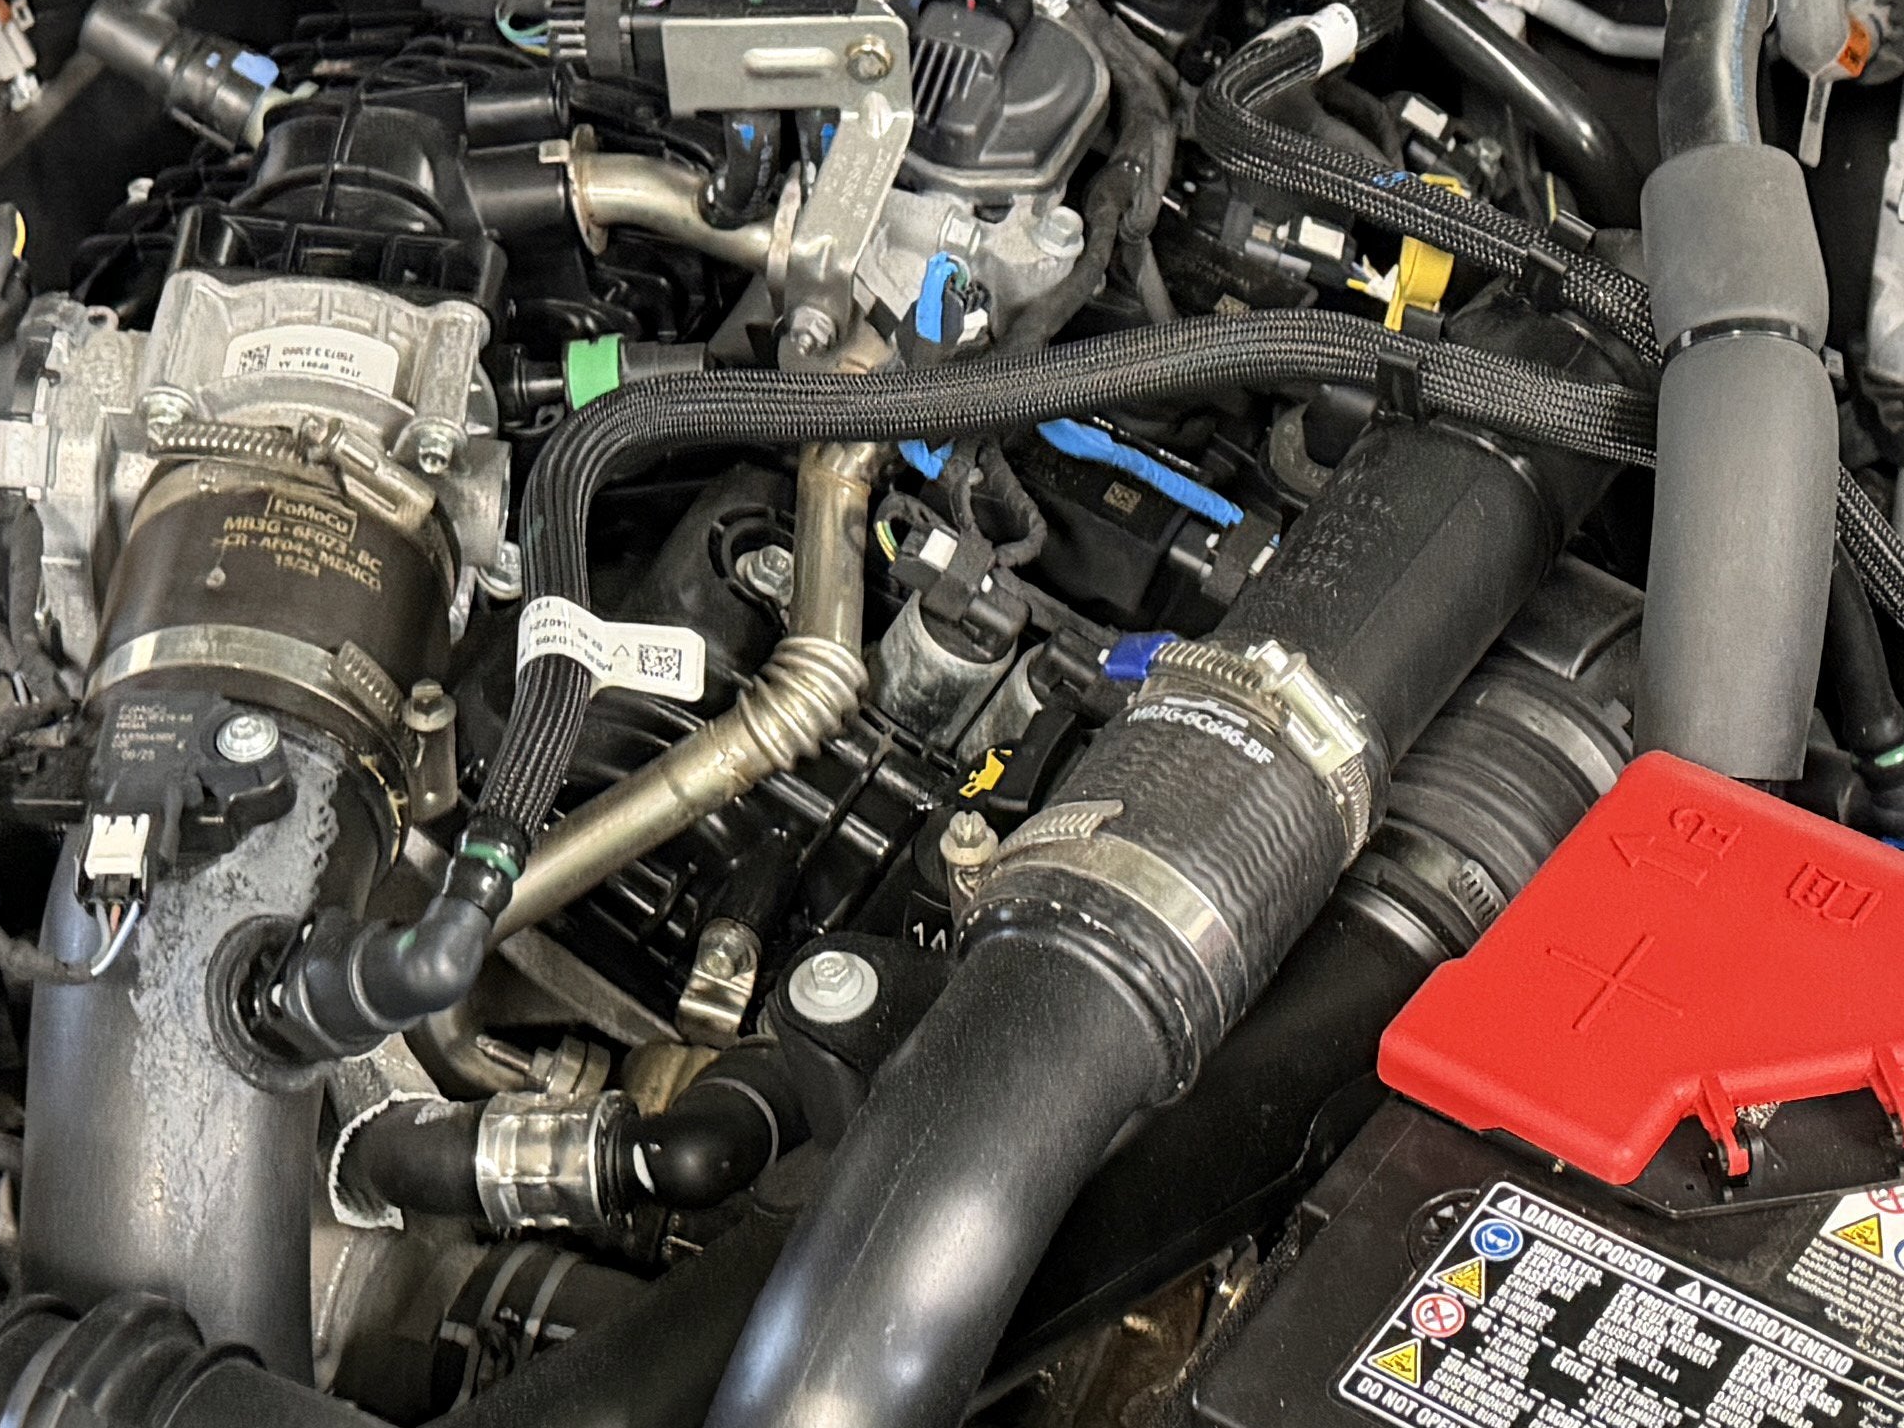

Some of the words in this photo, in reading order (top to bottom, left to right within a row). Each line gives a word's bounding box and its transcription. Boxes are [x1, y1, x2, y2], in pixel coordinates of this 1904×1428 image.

[1518, 1202, 1669, 1285] DANGER/POISON
[1527, 1239, 1574, 1269] SHIELD
[1502, 1272, 1543, 1299] CAUSE
[1510, 1261, 1554, 1290] GASES
[1547, 1280, 1577, 1302] CAN
[1518, 1250, 1588, 1292] EXPLOSIVE
[1616, 1281, 1639, 1300] SE
[1486, 1294, 1507, 1312] OR
[1494, 1283, 1559, 1322] BLINDNESS
[1470, 1313, 1494, 1333] NO
[1495, 1325, 1541, 1355] SPARKS
[1591, 1316, 1639, 1347] CAUSER
[1634, 1337, 1663, 1358] DES
[1600, 1304, 1669, 1345] EXPLOSIFS
[1661, 1335, 1718, 1370] PEUVENT
[1607, 1293, 1637, 1314] LES
[1667, 1321, 1695, 1343] LES
[1691, 1331, 1724, 1355] GAZ
[1698, 1289, 1858, 1377] PELIGRO/VENENO
[1478, 1346, 1531, 1380] SMOKING
[1487, 1335, 1533, 1366] FLAMES
[1583, 1327, 1650, 1368] BLESSURES
[1644, 1357, 1666, 1375] ET
[1659, 1365, 1682, 1384] LA
[1744, 1343, 1803, 1379] PROTEJA
[1798, 1369, 1830, 1392] LOS
[1354, 1375, 1385, 1400] DO
[1379, 1388, 1419, 1418] NOT
[1420, 1380, 1441, 1397] OR
[1436, 1387, 1478, 1416] SEVERE
[1429, 1367, 1467, 1393] CAUSE
[1461, 1383, 1521, 1421] BLINDNESS
[1438, 1353, 1493, 1389] SULFURIC
[1486, 1378, 1517, 1402] ACID
[1510, 1392, 1537, 1413] CAN
[1590, 1388, 1616, 1408] LES
[1599, 1377, 1625, 1396] LES
[1718, 1378, 1771, 1411] PUEDEN
[1726, 1366, 1809, 1414] EXPLOSIVOS
[1771, 1371, 1804, 1395] LOS
[1794, 1383, 1846, 1418] GASES
[1582, 1399, 1602, 1416] DE
